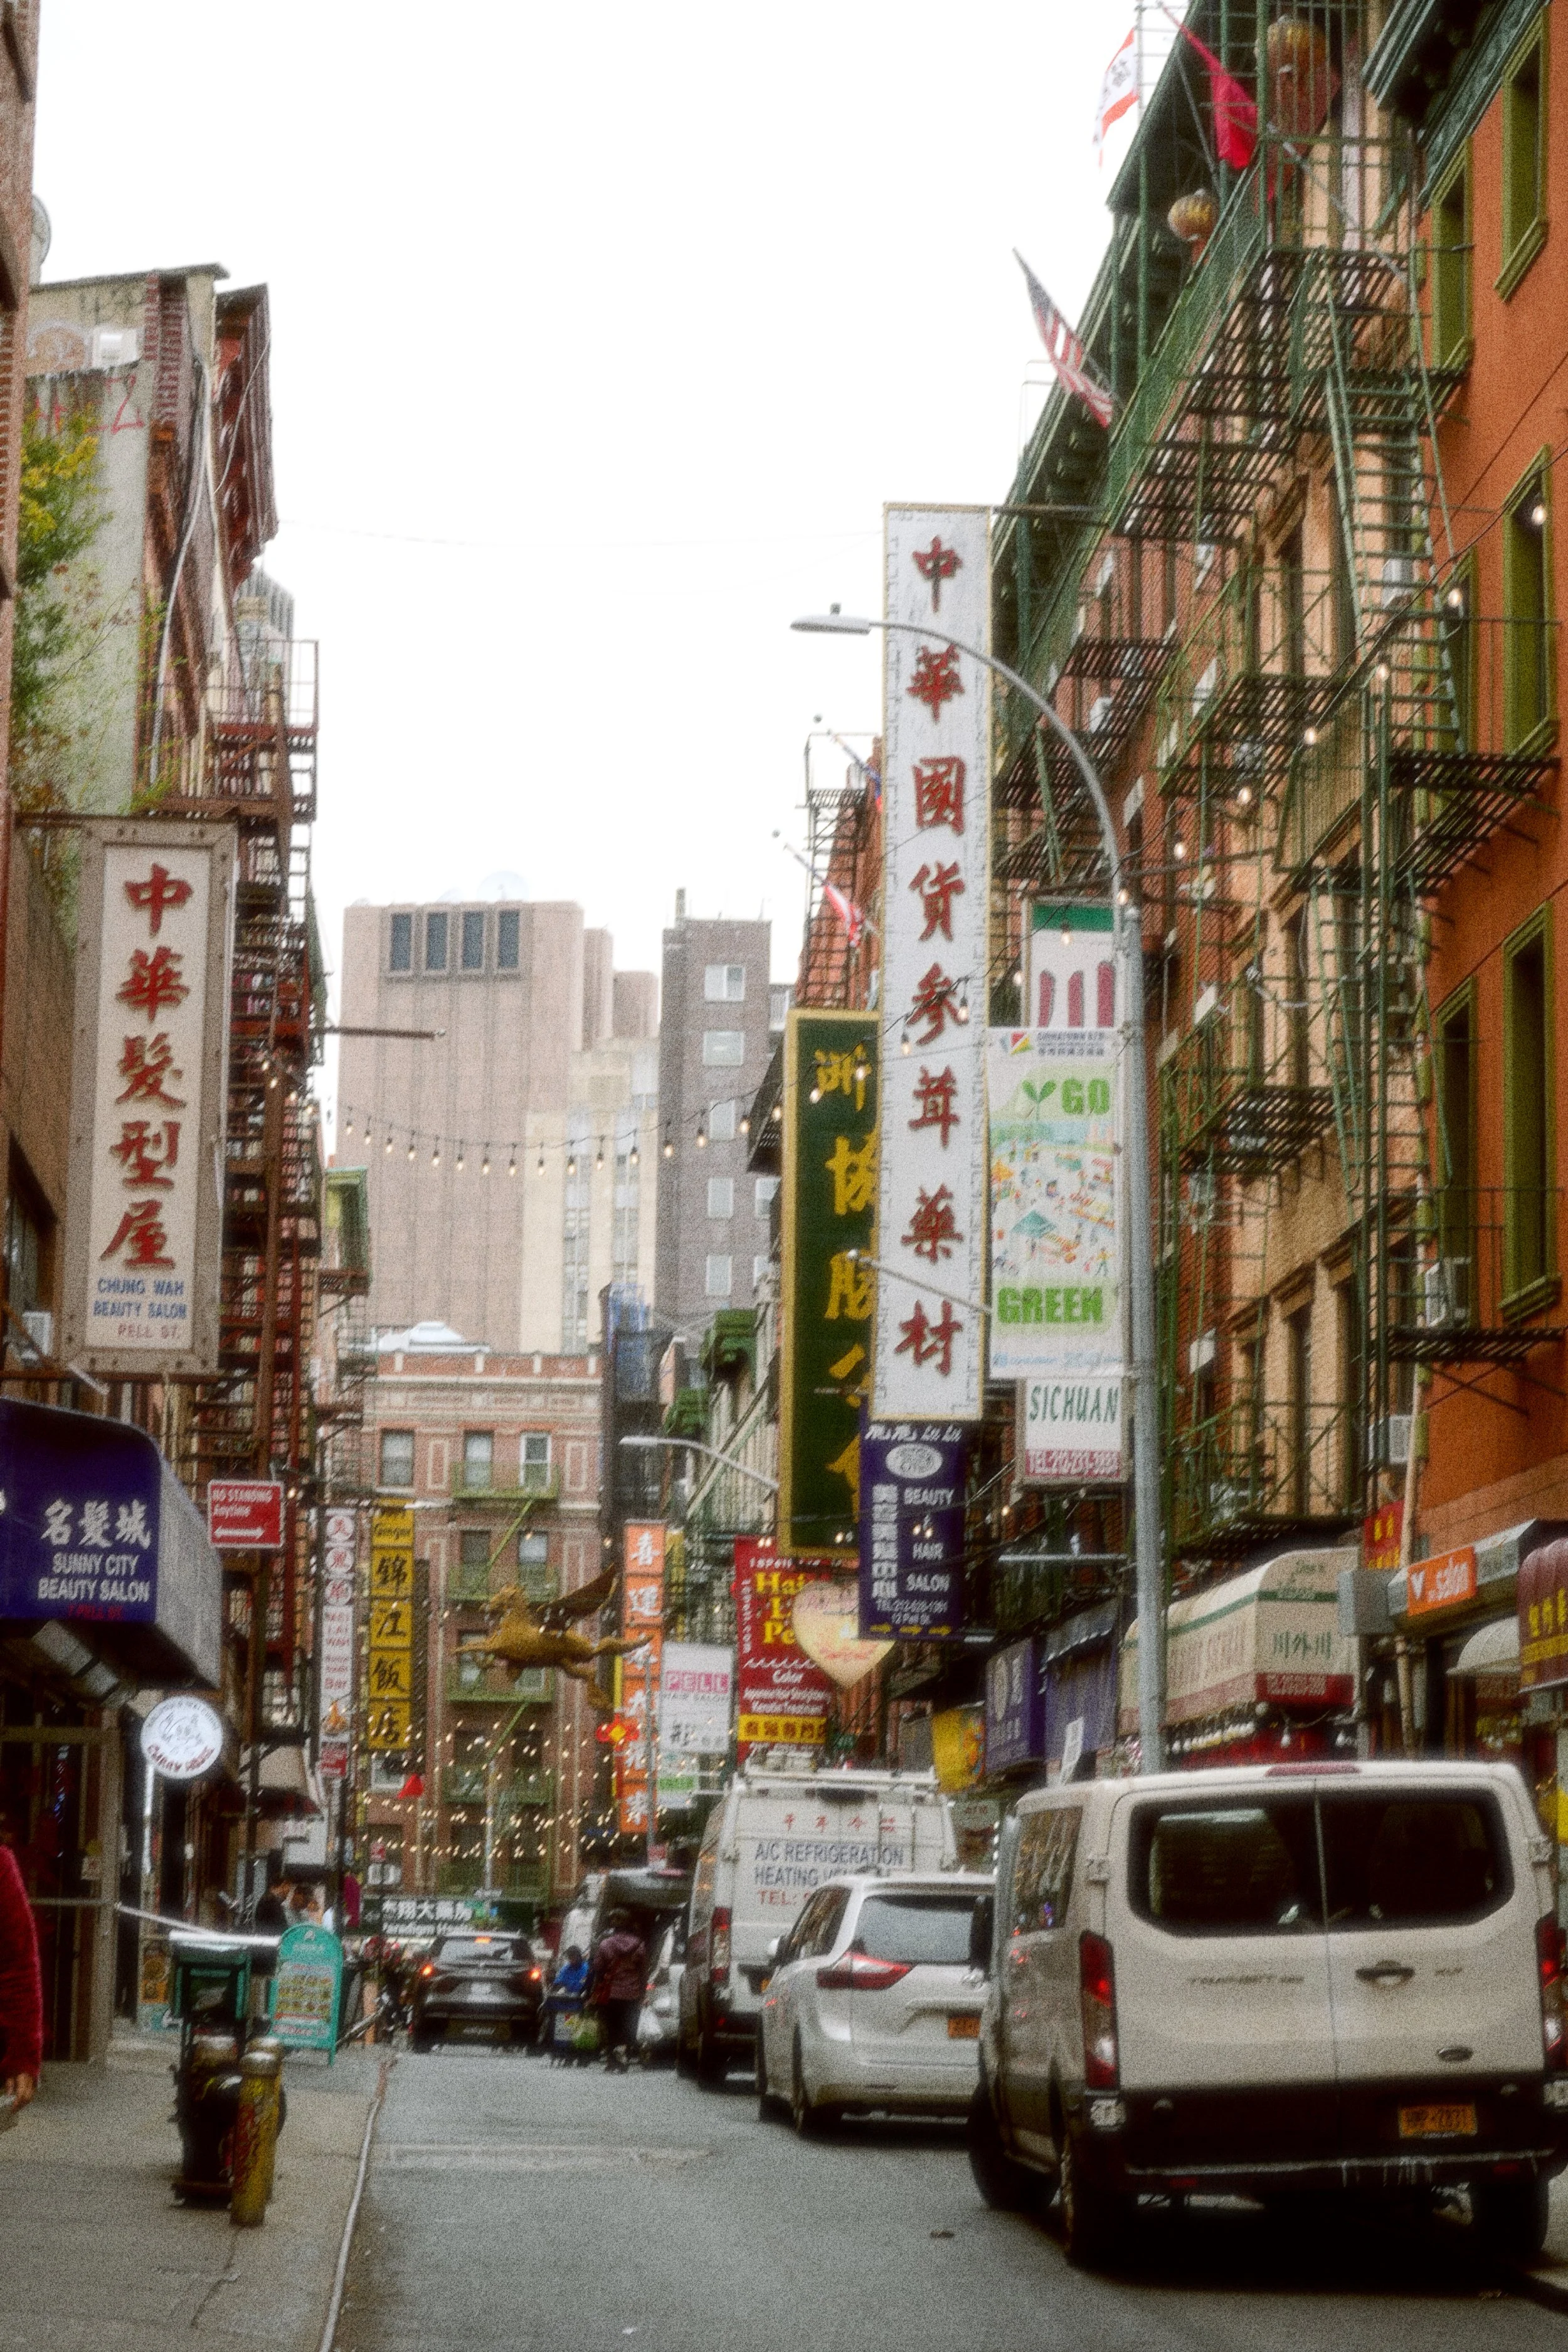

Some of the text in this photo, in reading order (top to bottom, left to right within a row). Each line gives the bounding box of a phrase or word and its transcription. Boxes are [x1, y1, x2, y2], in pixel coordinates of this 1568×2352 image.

[895, 534, 966, 1376] 中華國貨參茸藥材
[100, 862, 195, 1269] 中華髮型屋
[1062, 1078, 1110, 1115] GO
[97, 1277, 184, 1296] CHUNG WAH
[93, 1301, 188, 1319] BEAUTY SALON
[998, 1286, 1104, 1325] GREEN
[118, 1324, 152, 1338] PELL
[1029, 1385, 1120, 1423] SICHUAN
[213, 1488, 273, 1503] NO STANDING
[903, 1487, 954, 1505] BEAUTY
[41, 1498, 151, 1549] 名髮城
[913, 1543, 943, 1560] HAIR
[53, 1552, 139, 1576] SUNNY CITY
[38, 1577, 150, 1602] BEAUTY SALON
[755, 1571, 815, 1595] Hai
[906, 1574, 950, 1593] SALON
[372, 1555, 408, 1744] 錦江飯店
[666, 1671, 728, 1693] PELL
[147, 1744, 182, 1772] CURRY
[755, 1843, 904, 1865] A/C REFRIGERATON
[755, 1866, 818, 1887] HEATING
